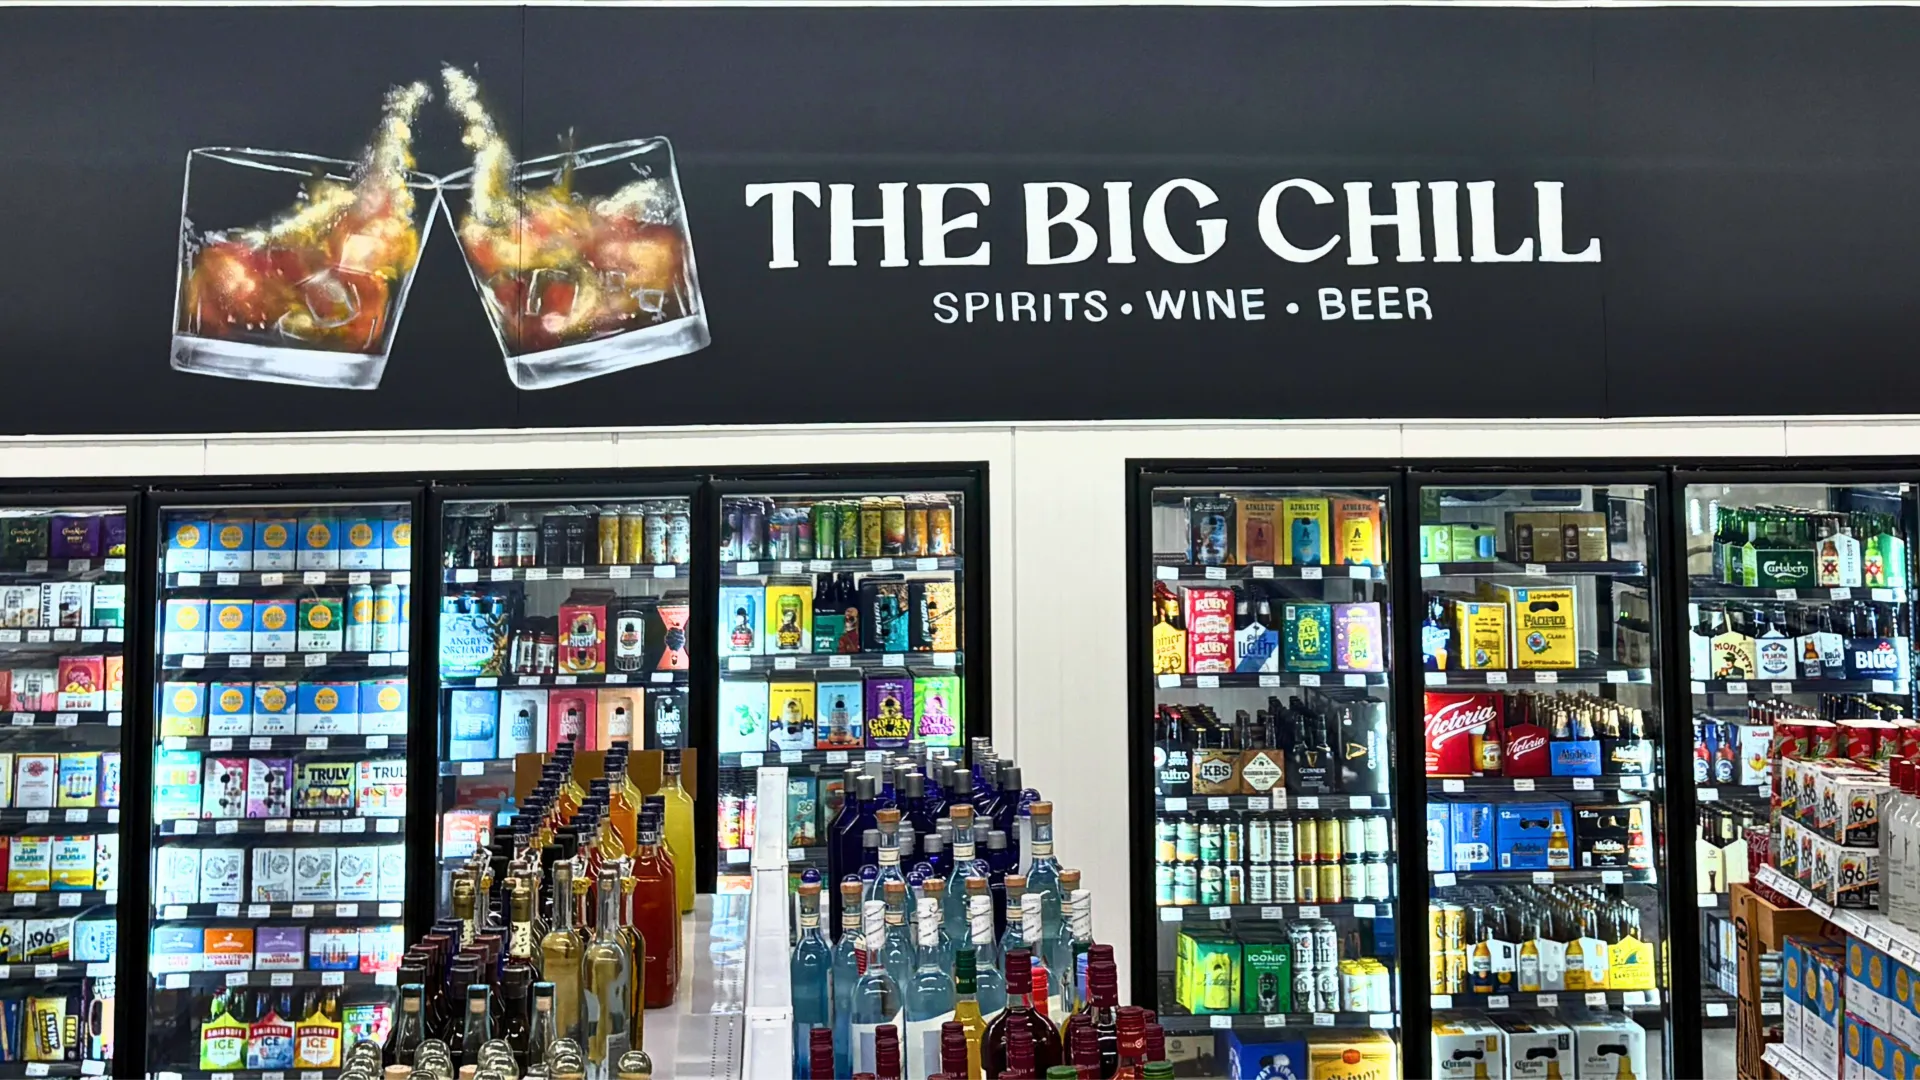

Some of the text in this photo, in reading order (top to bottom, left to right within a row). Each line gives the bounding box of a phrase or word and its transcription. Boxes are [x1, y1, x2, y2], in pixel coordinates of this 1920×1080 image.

[746, 179, 1601, 268] THE BIG CHILL
[934, 287, 1432, 323] SPIRITS WINE BEER
[1245, 503, 1275, 511] ATHLETIC
[1290, 503, 1321, 511] ATHLETIC
[1763, 559, 1809, 578] Carlsberg
[1195, 597, 1228, 611] RUBY
[450, 637, 481, 645] ANGRY
[443, 645, 489, 654] ORCHARD
[1195, 641, 1228, 655] RUBY
[1239, 641, 1275, 659] LIGHT
[1714, 643, 1753, 675] MORETTI
[1855, 651, 1898, 669] Blue
[869, 718, 911, 731] GOLDEN
[1424, 696, 1497, 750] Victoria
[1506, 733, 1546, 760] Victoria
[309, 768, 350, 780] TRULY
[373, 767, 406, 777] TRUL
[1161, 769, 1190, 780] nitro
[1203, 765, 1230, 776] KBS
[1248, 954, 1286, 962] ICONIC
[207, 1029, 243, 1037] SMIRNOFF
[253, 1027, 289, 1035] SMIRNOFF
[300, 1027, 336, 1036] SMIRNOFF
[213, 1039, 234, 1049] ICE
[261, 1037, 280, 1046] ICE
[306, 1037, 327, 1048] ICE
[1441, 1059, 1472, 1070] Corona
[1514, 1058, 1544, 1070] Corona
